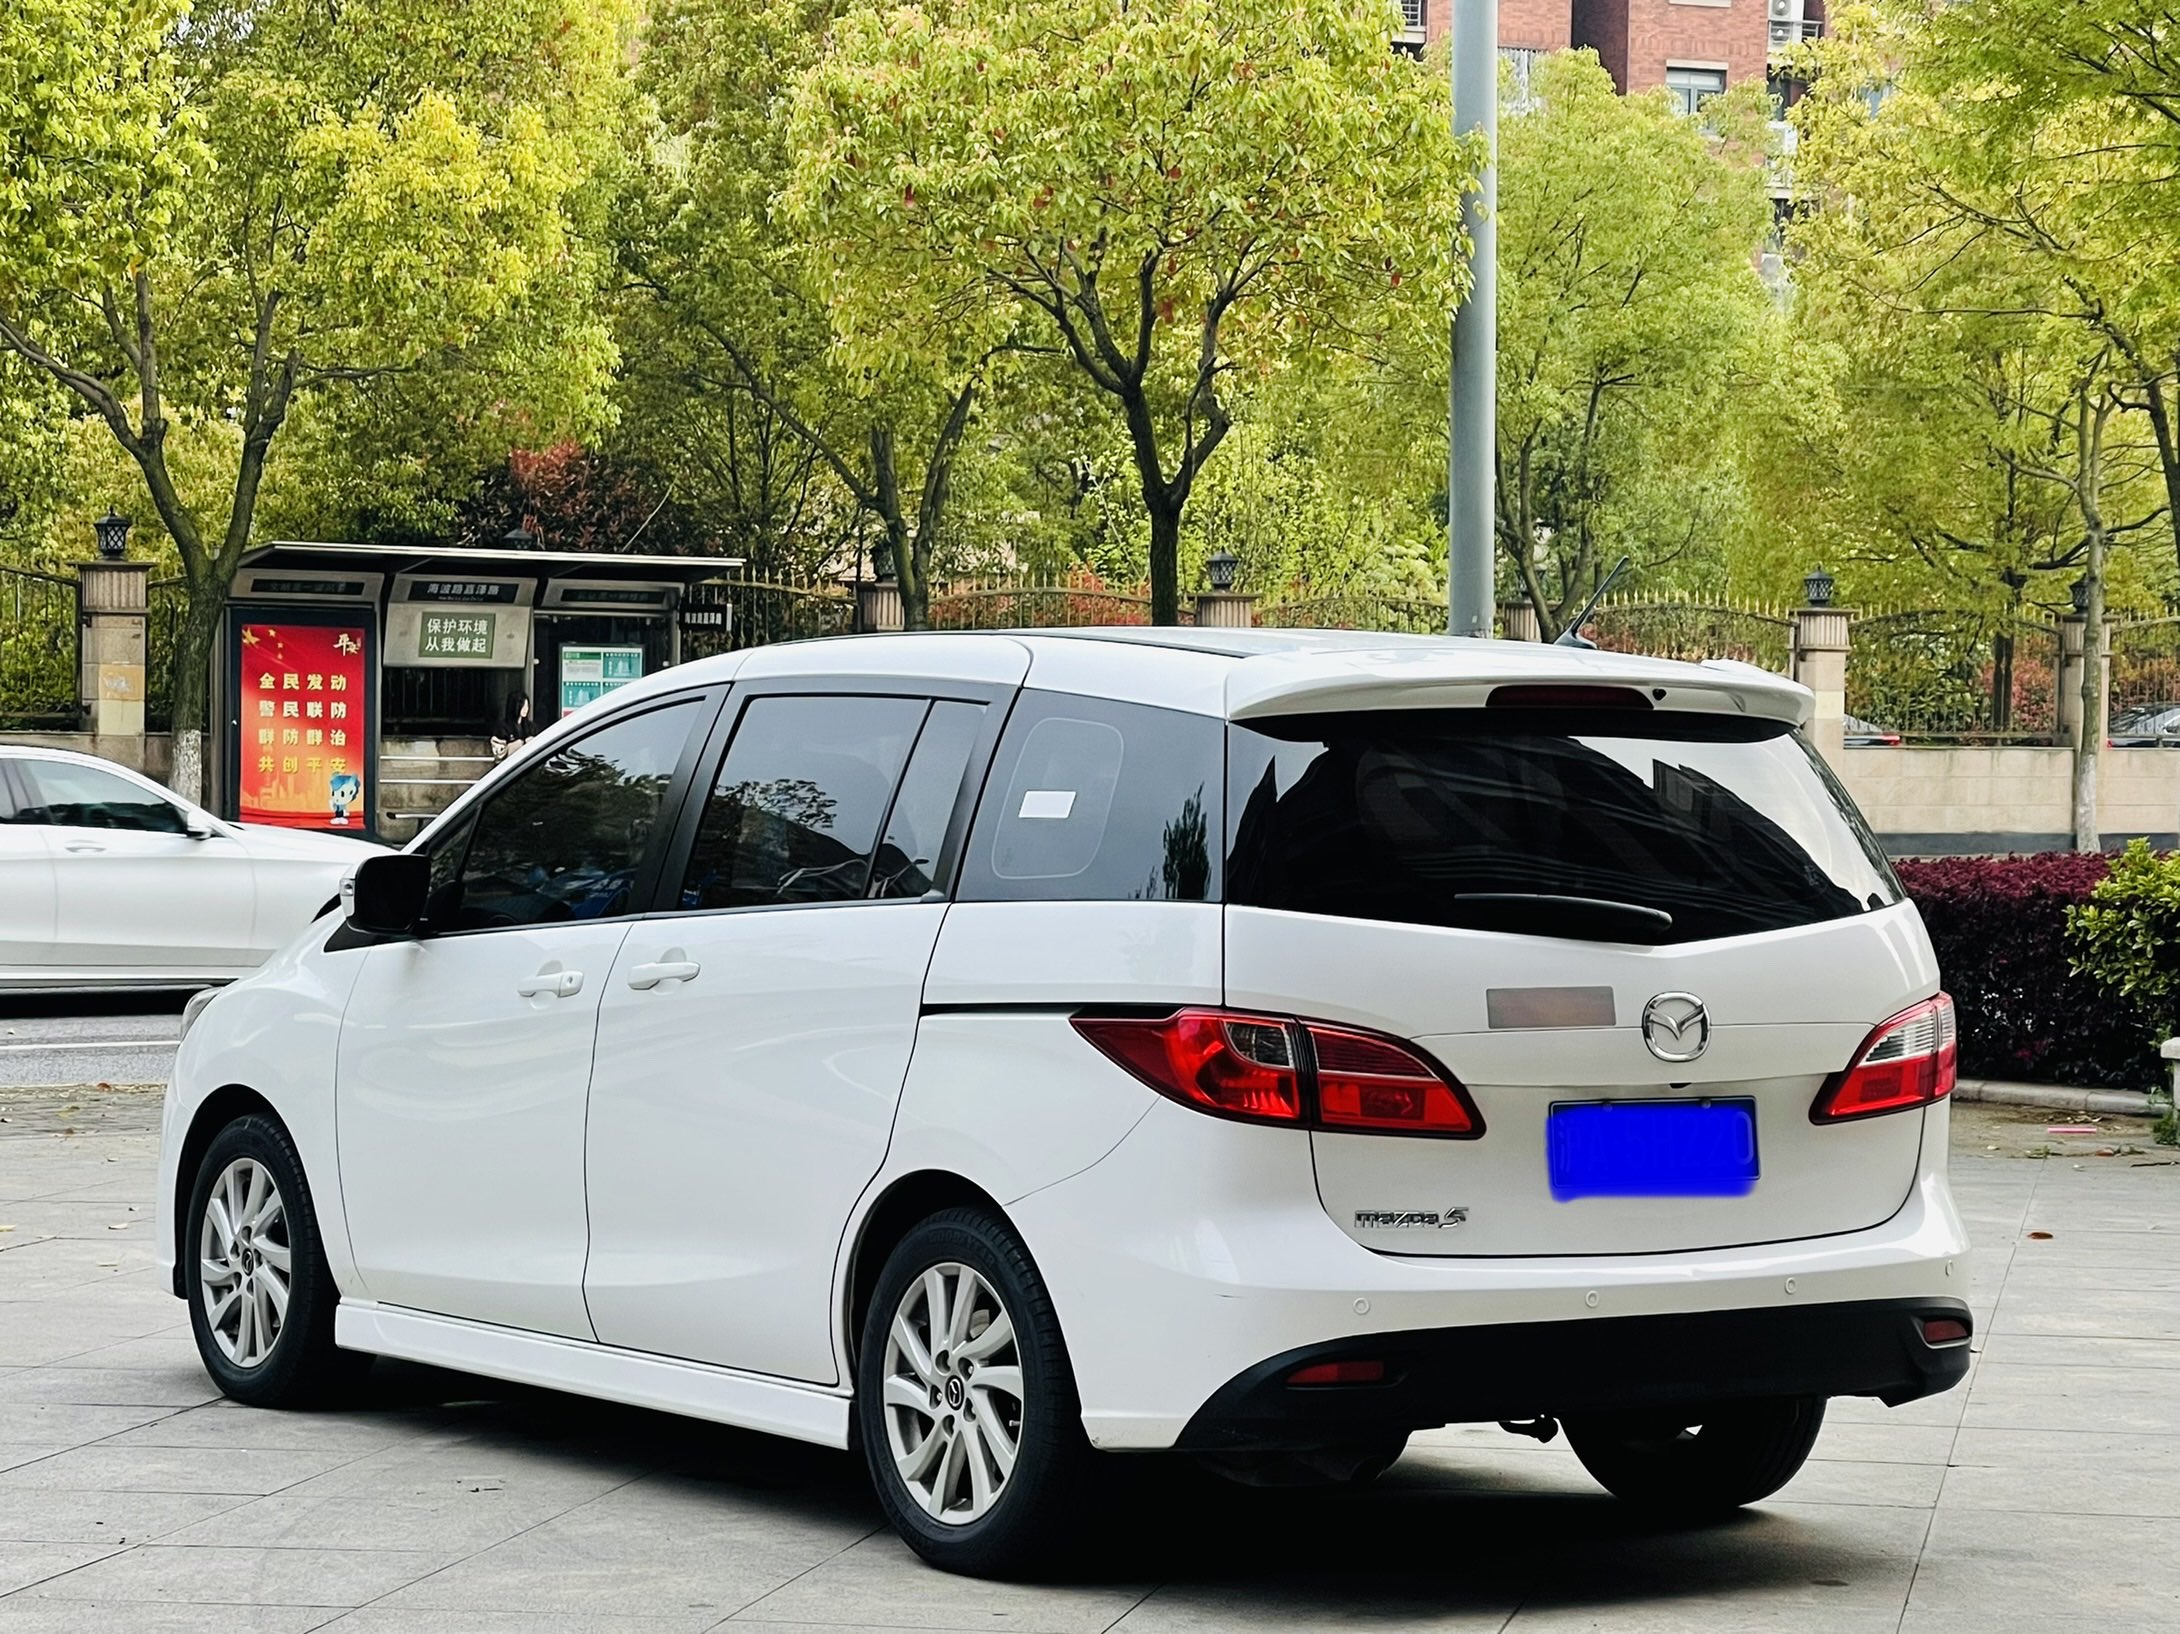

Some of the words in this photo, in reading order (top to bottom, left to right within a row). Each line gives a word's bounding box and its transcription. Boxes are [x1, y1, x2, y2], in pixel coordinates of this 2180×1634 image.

[427, 618, 488, 635] 保护环境
[425, 636, 486, 653] 从我做起
[259, 672, 347, 691] 全民发动
[259, 700, 347, 719] 警民联防
[258, 728, 346, 746] 群防群治
[258, 755, 346, 773] 共创平安
